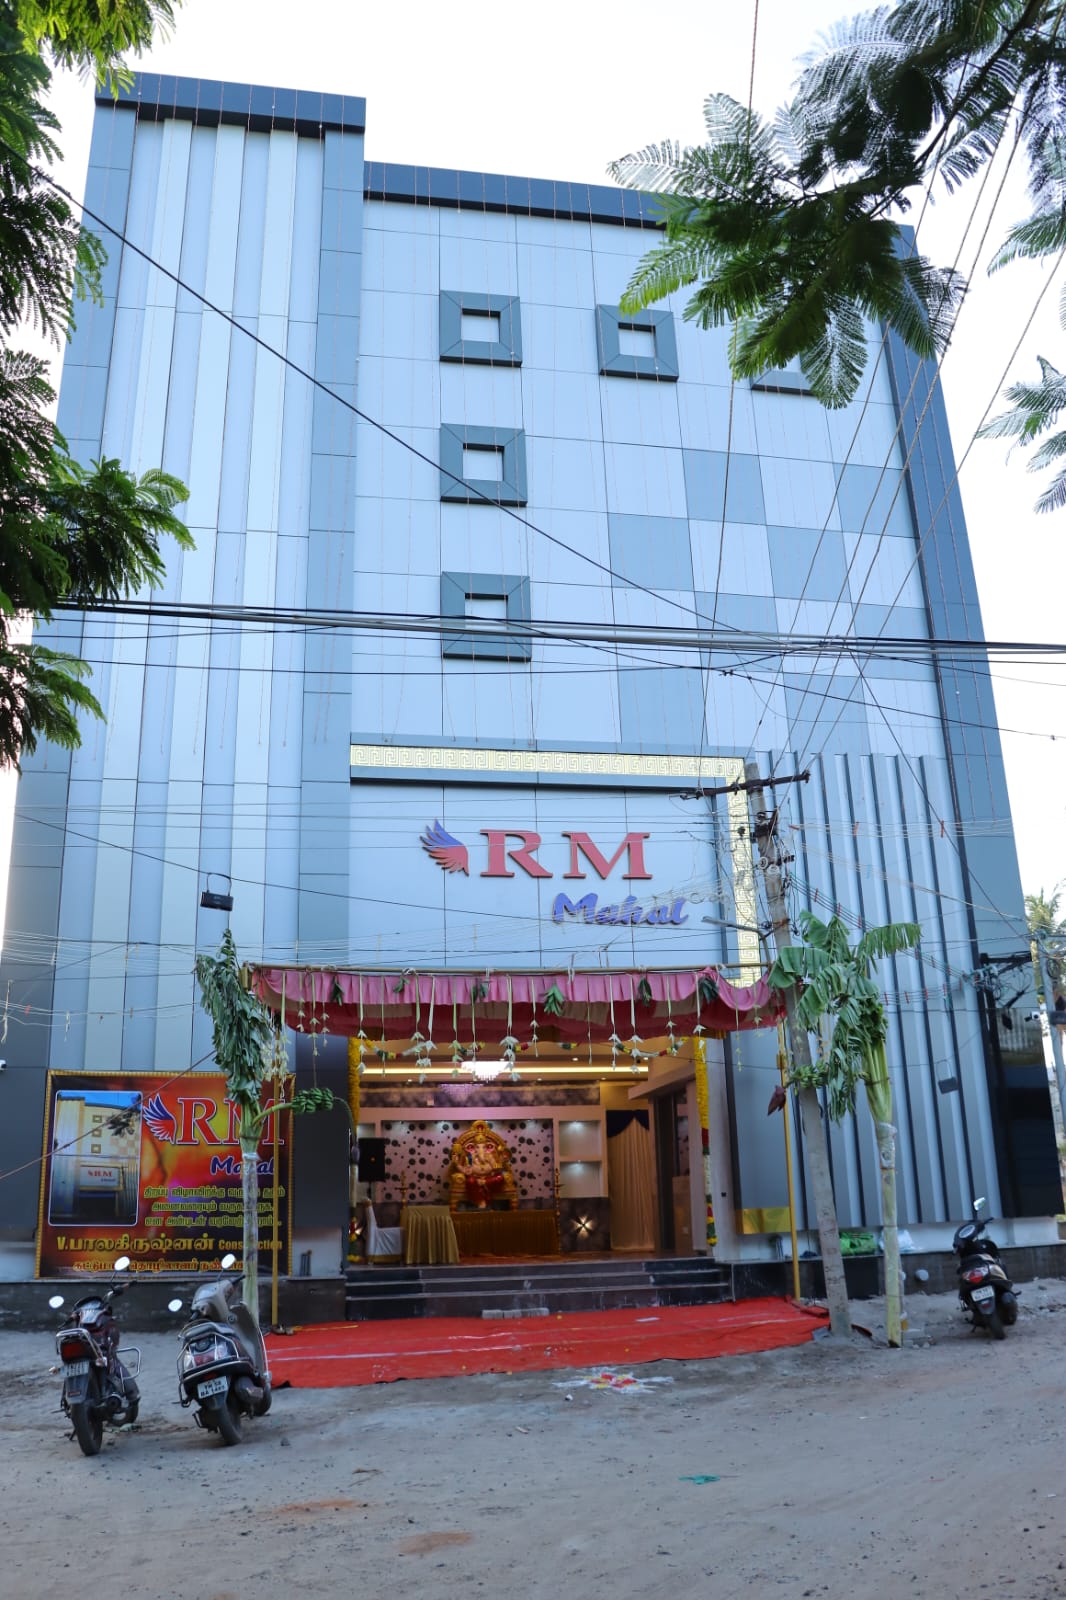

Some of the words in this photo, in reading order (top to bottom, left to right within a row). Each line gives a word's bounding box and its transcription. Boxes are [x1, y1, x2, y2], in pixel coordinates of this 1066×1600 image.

[480, 829, 653, 879] RM
[552, 892, 689, 925] Mahal
[210, 1156, 274, 1175] Maal
